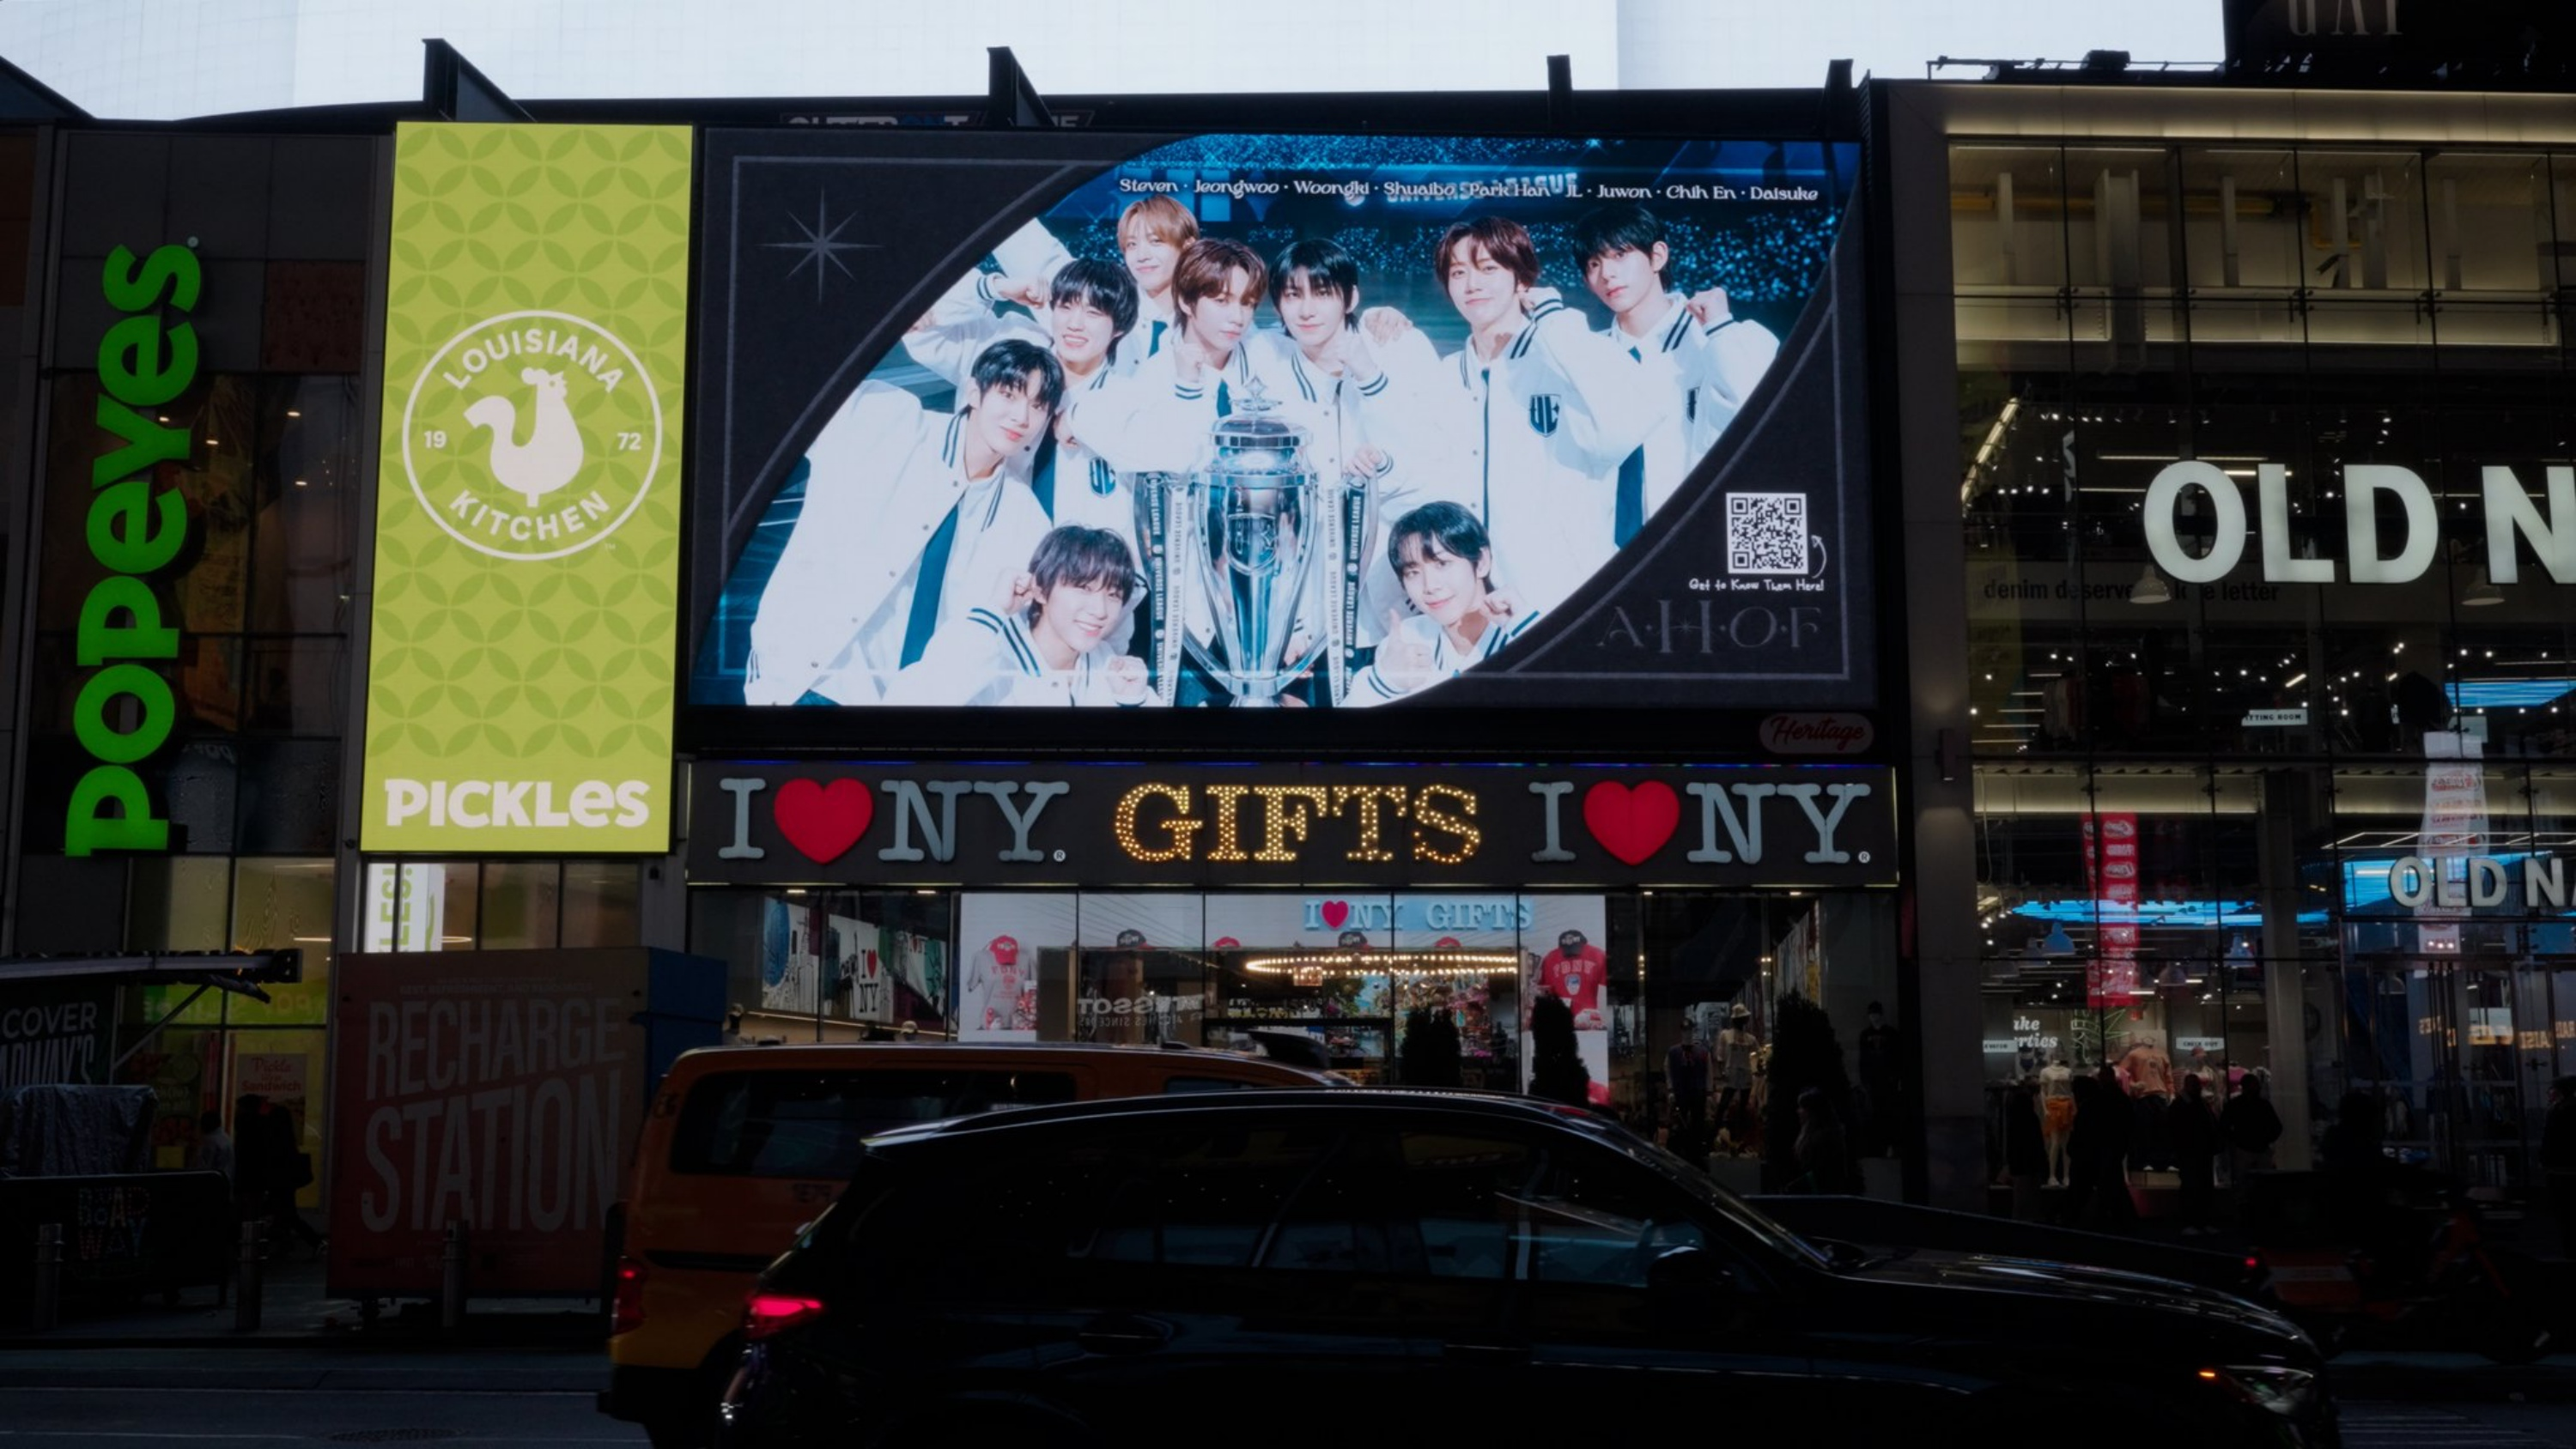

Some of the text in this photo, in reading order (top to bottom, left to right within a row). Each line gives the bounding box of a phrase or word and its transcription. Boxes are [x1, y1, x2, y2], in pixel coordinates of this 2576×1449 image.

[1120, 179, 1178, 194] Steven
[1194, 179, 1279, 199] Jeongwoo
[1294, 180, 1370, 199] Woongki
[1383, 181, 1455, 197] Shuaibo
[1469, 182, 1510, 197] Park
[1514, 183, 1551, 197] Han
[1564, 183, 1583, 197] JL
[1596, 184, 1652, 198] Juwon
[1666, 184, 1709, 200] Chih
[1713, 185, 1736, 199] En
[1750, 185, 1819, 201] Daisuke
[443, 328, 624, 393] LOUISIANA
[423, 431, 447, 450] 19
[617, 432, 642, 451] 72
[449, 489, 611, 540] KITCHEN
[2143, 459, 2440, 585] OLD
[1688, 579, 1825, 592] Get to Know Them Here!
[1984, 579, 2049, 600] denim
[2055, 579, 2133, 600] deserve
[2222, 580, 2280, 601] letter
[1769, 715, 1866, 750] Heritage
[718, 777, 767, 860] I
[1114, 782, 1481, 864] GIFTS
[1528, 780, 1577, 864] I
[2389, 855, 2576, 908] OLD N
[1303, 900, 1534, 931] I NY GIFTS
[0, 1001, 98, 1040] COVER
[367, 997, 627, 1102] RECHARGE
[360, 1070, 625, 1234] STATION
